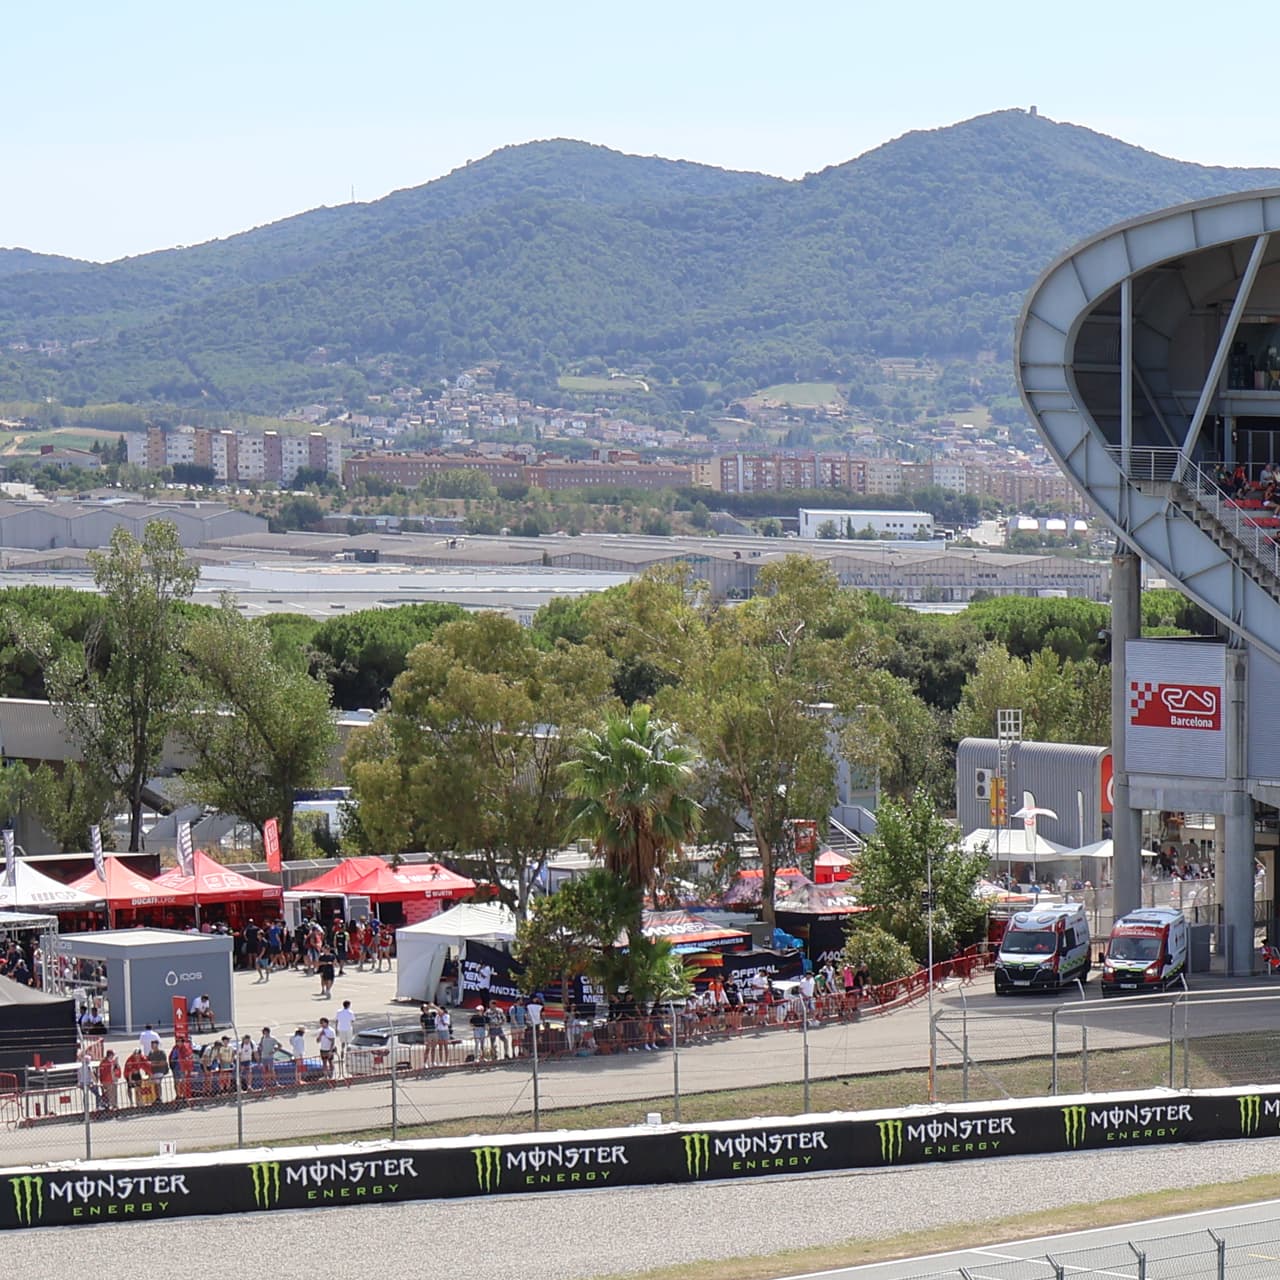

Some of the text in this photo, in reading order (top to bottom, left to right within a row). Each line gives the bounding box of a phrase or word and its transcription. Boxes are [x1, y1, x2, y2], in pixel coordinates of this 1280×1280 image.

[1170, 715, 1213, 728] Barcelona
[1091, 1104, 1193, 1130] MONSTER
[907, 1116, 1015, 1143] MONSTER
[1106, 1127, 1179, 1142] ENERGY
[714, 1131, 829, 1158] MONSTER
[924, 1140, 1002, 1156] ENERGY
[507, 1145, 628, 1174] MONSTER
[733, 1155, 814, 1172] ENERGY
[286, 1157, 418, 1187] MONSTER
[526, 1170, 610, 1186] ENERGY
[49, 1173, 190, 1202] MONSTER
[307, 1184, 400, 1201] ENERGY
[73, 1201, 171, 1217] ENERGY
